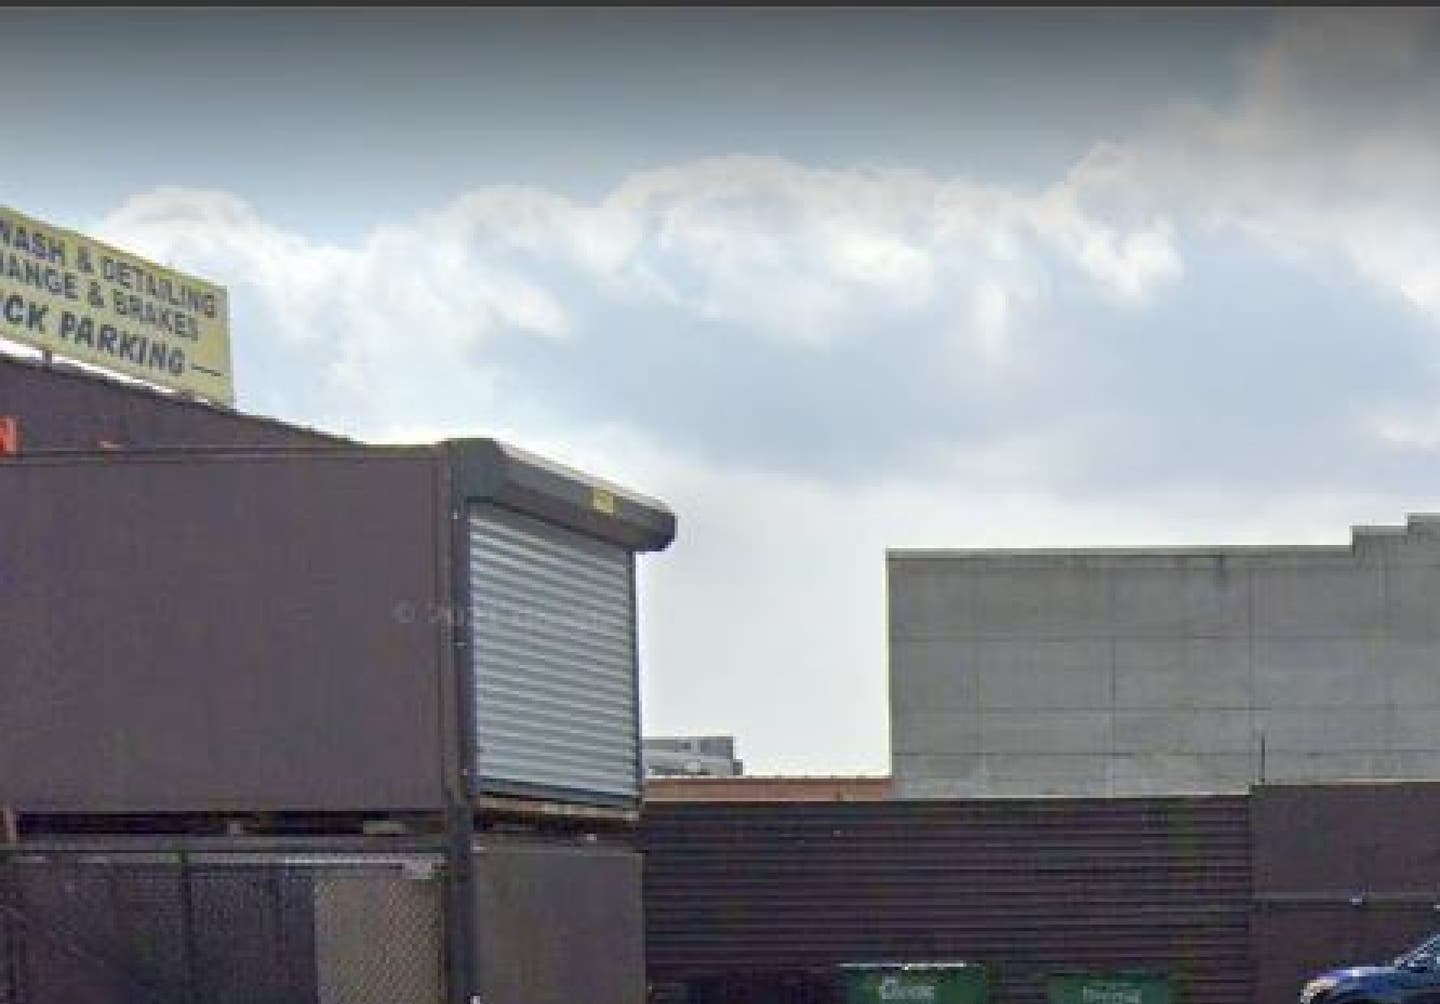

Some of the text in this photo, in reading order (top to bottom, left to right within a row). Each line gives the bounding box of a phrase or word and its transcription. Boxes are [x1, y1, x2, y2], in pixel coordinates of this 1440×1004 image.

[0, 250, 199, 342] ANGE & BRAKES
[77, 247, 94, 274] &
[103, 257, 217, 319] DETAILING
[60, 311, 187, 376] PARKING
